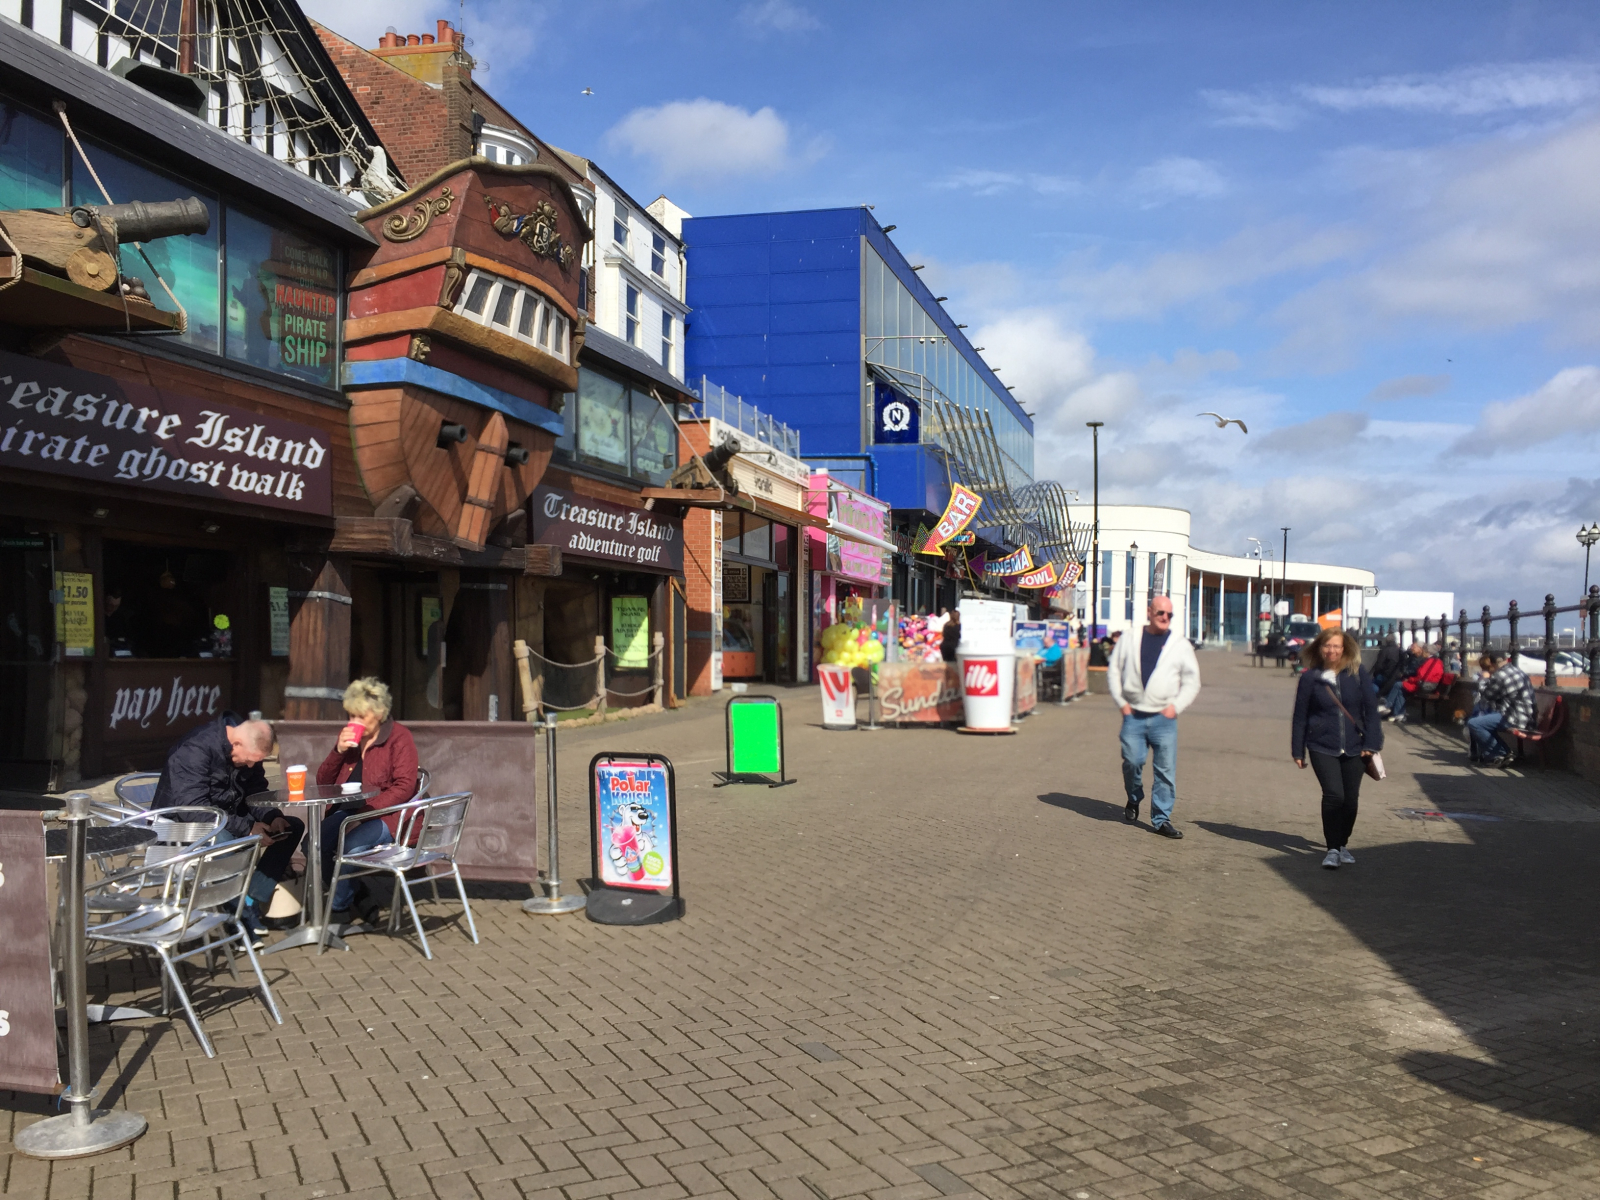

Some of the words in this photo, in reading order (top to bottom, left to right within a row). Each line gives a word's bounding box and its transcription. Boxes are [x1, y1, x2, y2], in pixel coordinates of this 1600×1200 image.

[284, 246, 306, 262] COME
[308, 252, 329, 269] WALK
[289, 261, 328, 280] AROUND
[274, 284, 336, 315] HAUNTED
[284, 314, 327, 340] PIRATE
[284, 335, 327, 368] SHIP
[185, 410, 326, 469] Island
[0, 419, 110, 467] irate
[113, 445, 226, 487] ghost
[227, 463, 305, 501] walk
[543, 492, 624, 532] Treasure
[626, 511, 675, 542] Island
[938, 491, 977, 538] BAR
[568, 531, 636, 558] adventure
[636, 545, 662, 563] golf
[984, 553, 1030, 574] CINEMA
[1017, 571, 1053, 586] BOWL
[965, 664, 997, 694] illy
[109, 686, 162, 729] pay
[166, 676, 220, 726] here
[881, 679, 963, 719] Sunda
[610, 775, 650, 792] Polar
[612, 791, 652, 805] KRUSH
